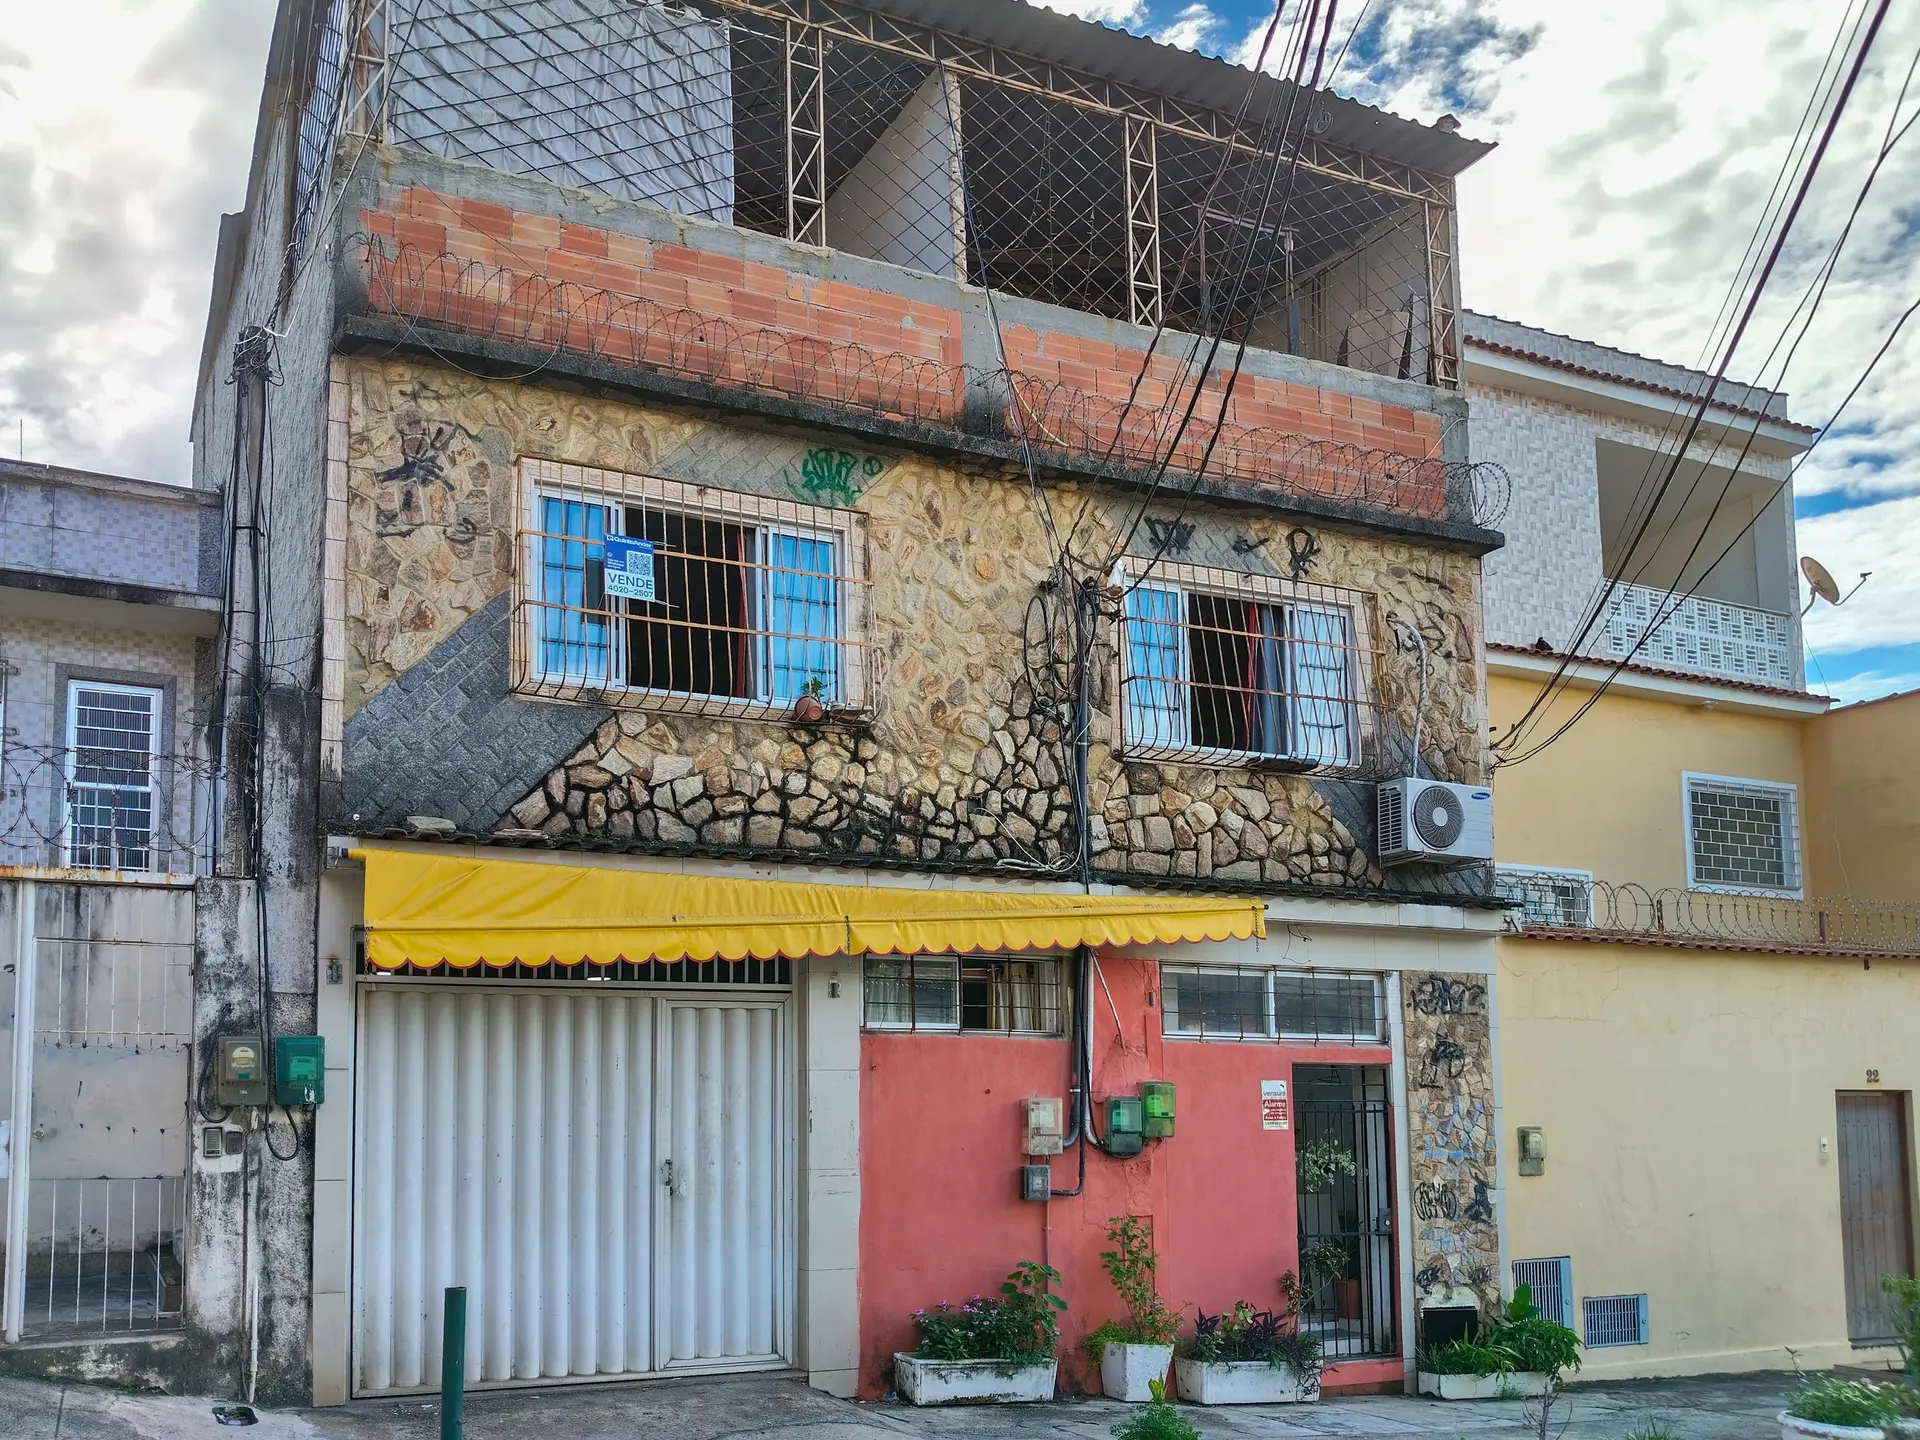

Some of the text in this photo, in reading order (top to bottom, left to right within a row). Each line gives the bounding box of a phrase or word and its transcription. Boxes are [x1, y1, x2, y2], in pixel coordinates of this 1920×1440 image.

[614, 536, 652, 548] QuintoAndar
[608, 572, 653, 590] VENDE
[608, 584, 653, 597] 4020-2507
[1866, 1070, 1879, 1083] 22
